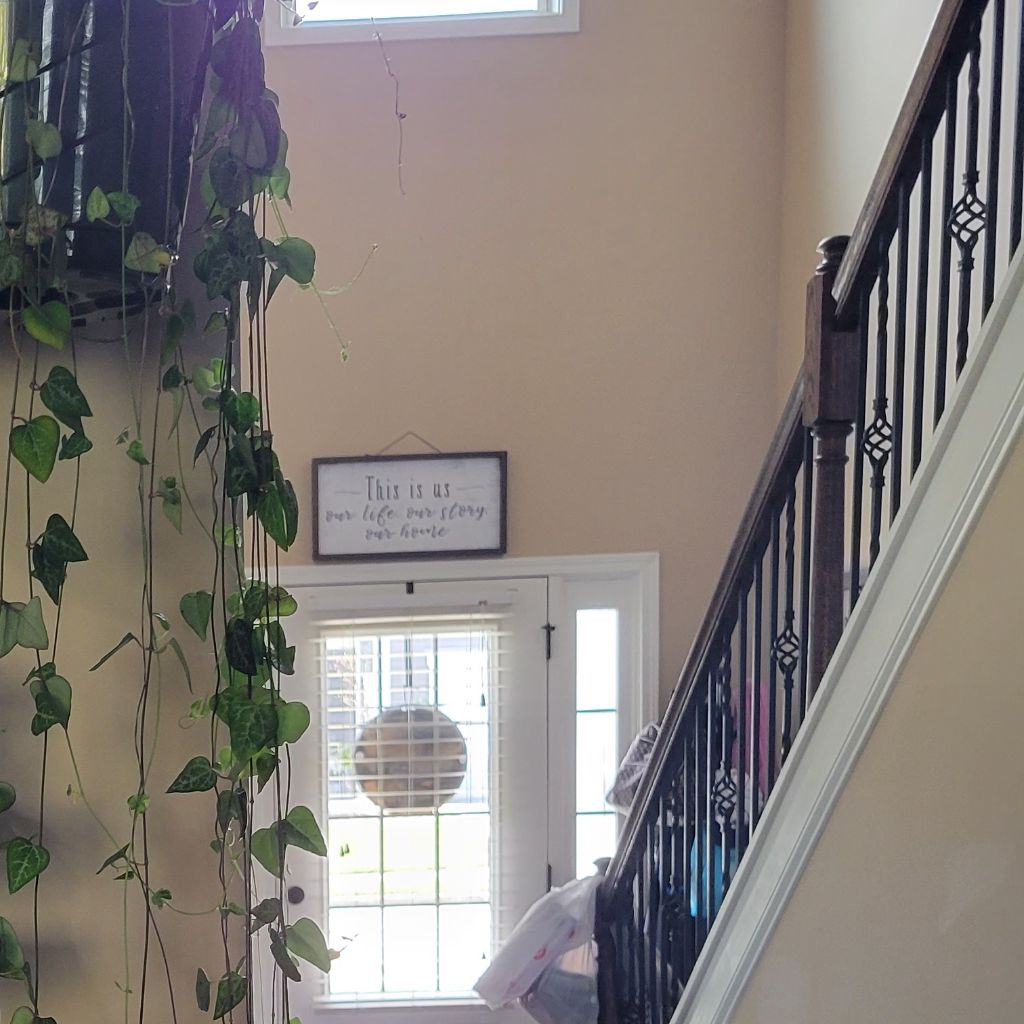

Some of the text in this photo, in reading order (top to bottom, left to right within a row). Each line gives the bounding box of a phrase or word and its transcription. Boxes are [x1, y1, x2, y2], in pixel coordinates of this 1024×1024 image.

[365, 475, 451, 501] This is us
